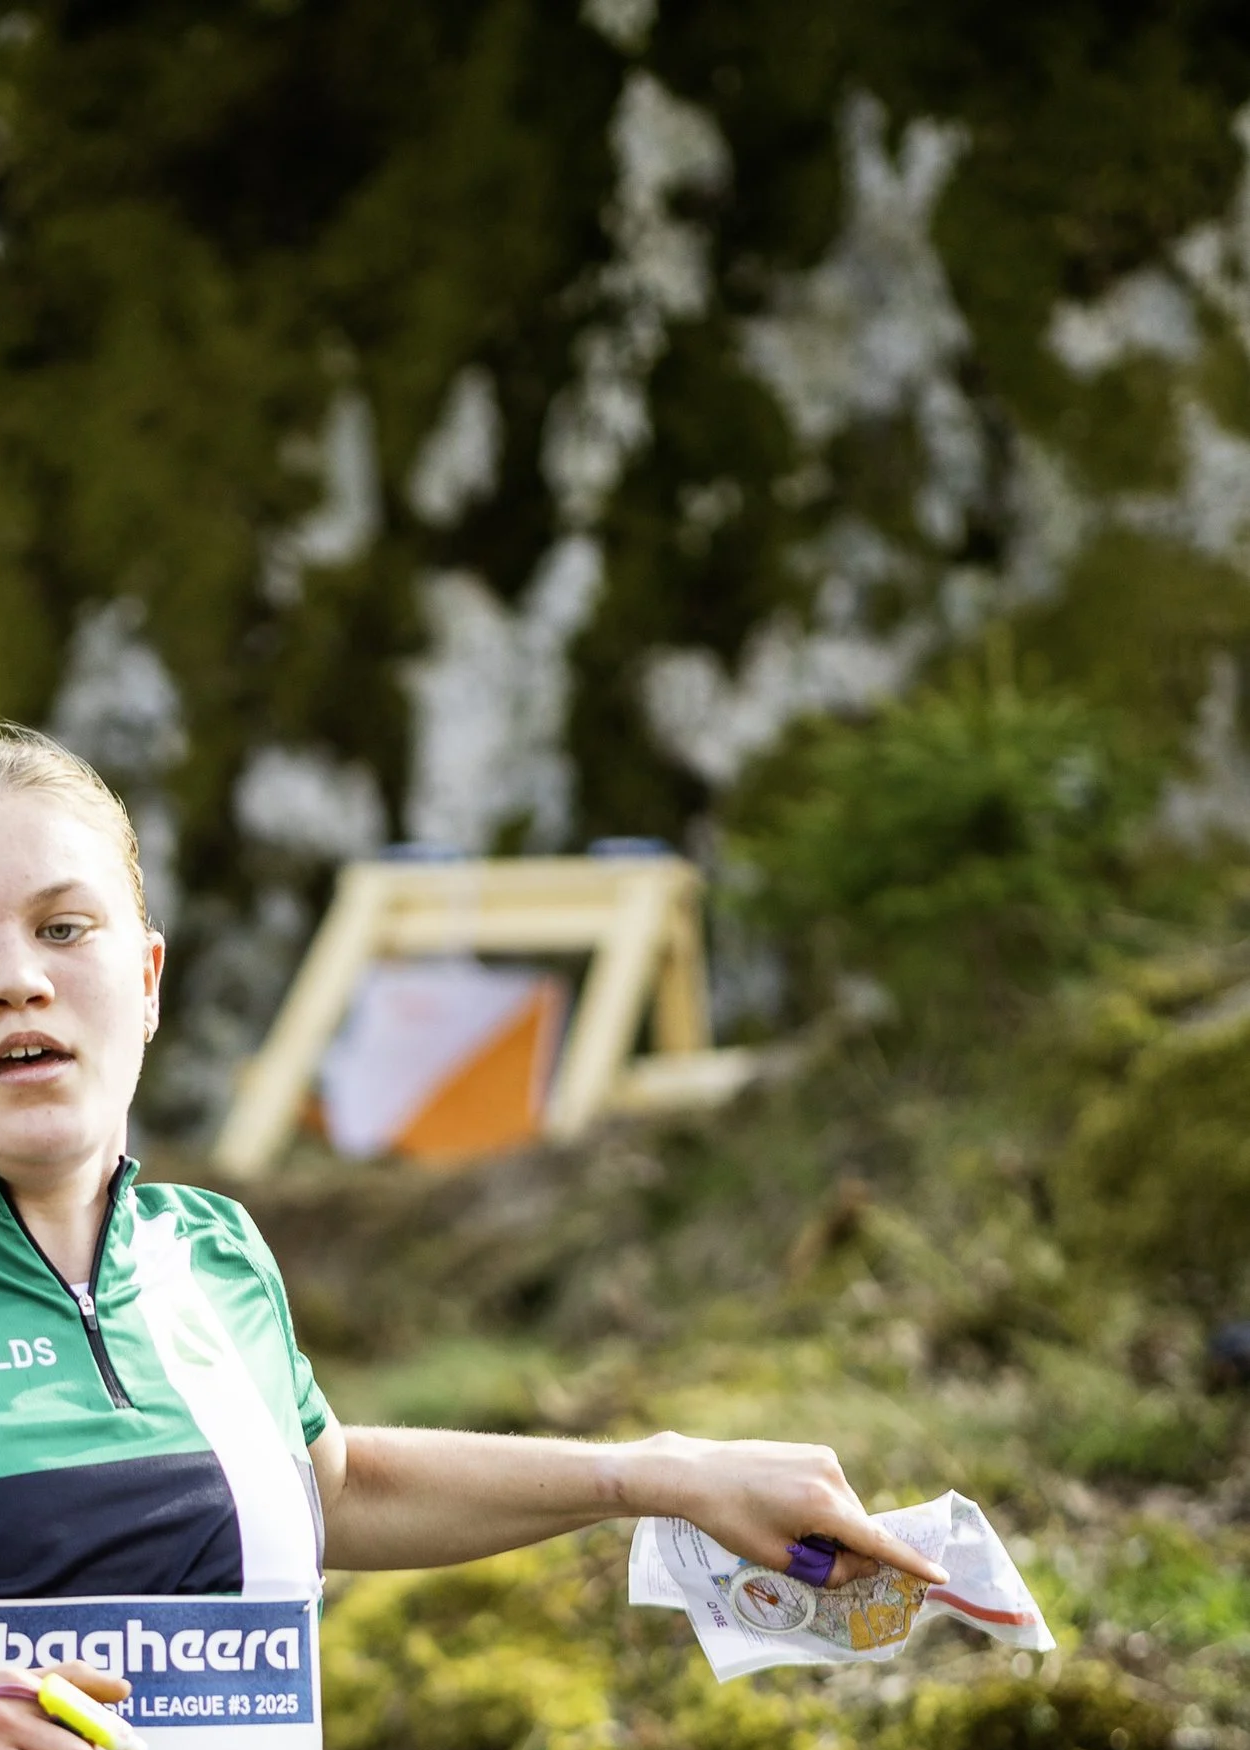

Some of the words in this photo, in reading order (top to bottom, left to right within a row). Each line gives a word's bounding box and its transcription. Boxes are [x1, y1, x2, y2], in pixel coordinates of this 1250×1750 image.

[140, 1695, 226, 1717] LEAGUE
[227, 1694, 251, 1716] #3
[254, 1693, 299, 1715] 2025
